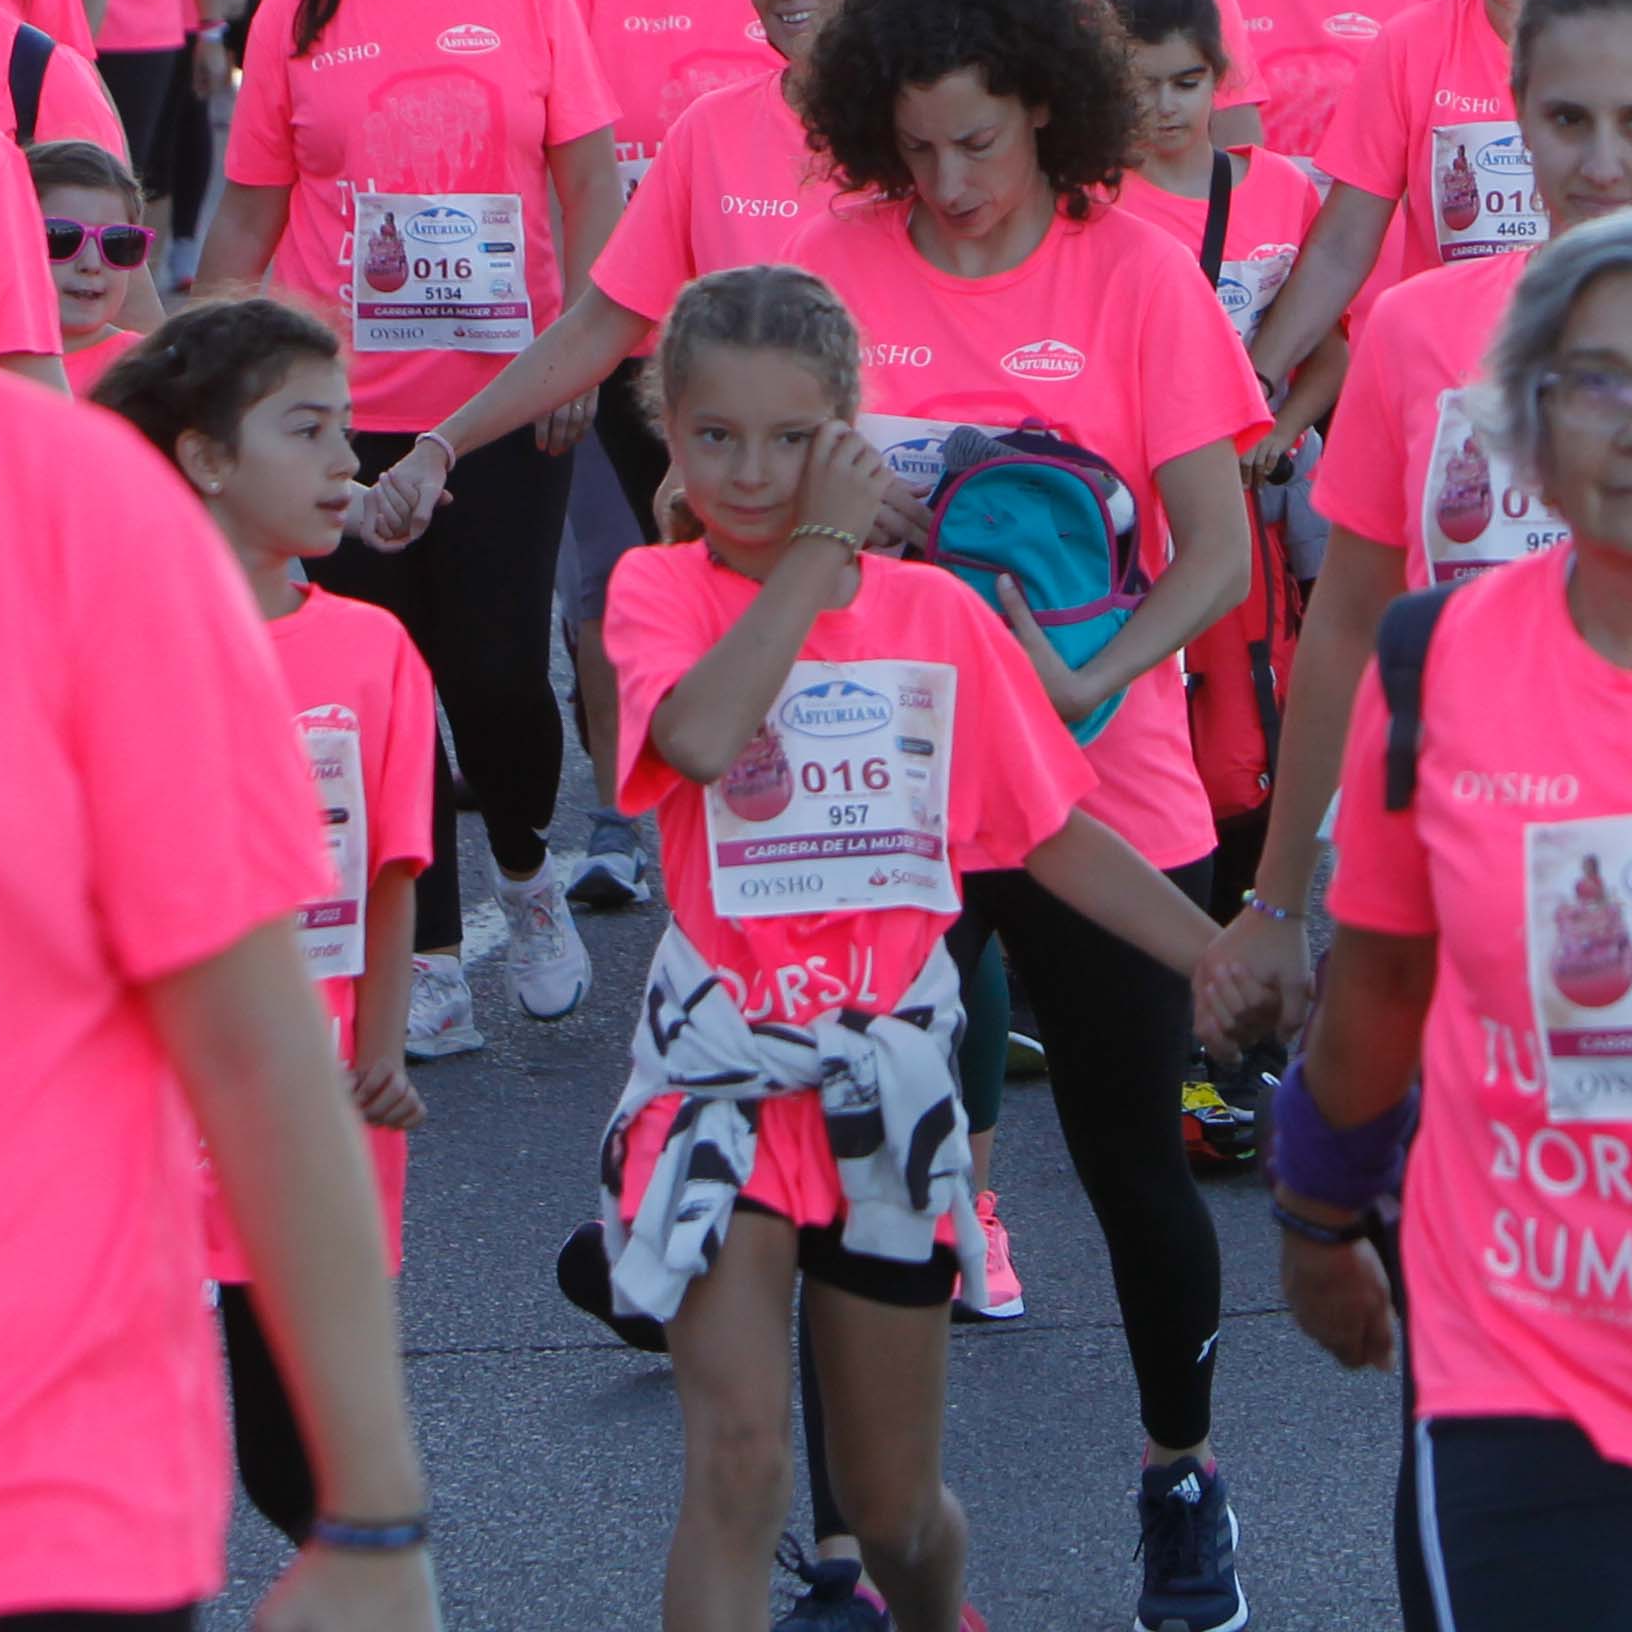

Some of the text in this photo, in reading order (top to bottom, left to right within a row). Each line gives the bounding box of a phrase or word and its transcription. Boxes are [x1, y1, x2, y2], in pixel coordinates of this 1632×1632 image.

[624, 15, 692, 32] OYSHO
[311, 42, 381, 72] OYSHO
[1435, 89, 1501, 114] OYSHO
[721, 195, 798, 217] OYSHO
[410, 219, 474, 237] ASTURIANA
[1497, 221, 1537, 236] 4463
[413, 258, 472, 281] 016
[424, 287, 462, 300] 5134
[374, 308, 421, 317] CARRERA
[424, 308, 438, 317] DE
[440, 308, 453, 317] LA
[456, 307, 491, 317] MUJER
[370, 327, 424, 341] OYSHO
[467, 326, 520, 340] Santander
[1009, 357, 1081, 371] ASTURIANA
[791, 704, 887, 725] ASTURIANA
[801, 757, 891, 793] 016
[1453, 772, 1579, 805] OYSHO
[828, 804, 869, 826] 957
[745, 841, 819, 859] CARRERA
[825, 839, 842, 852] DE
[847, 837, 866, 850] LA
[740, 873, 824, 898] OYSHO
[1481, 1017, 1541, 1093] TU
